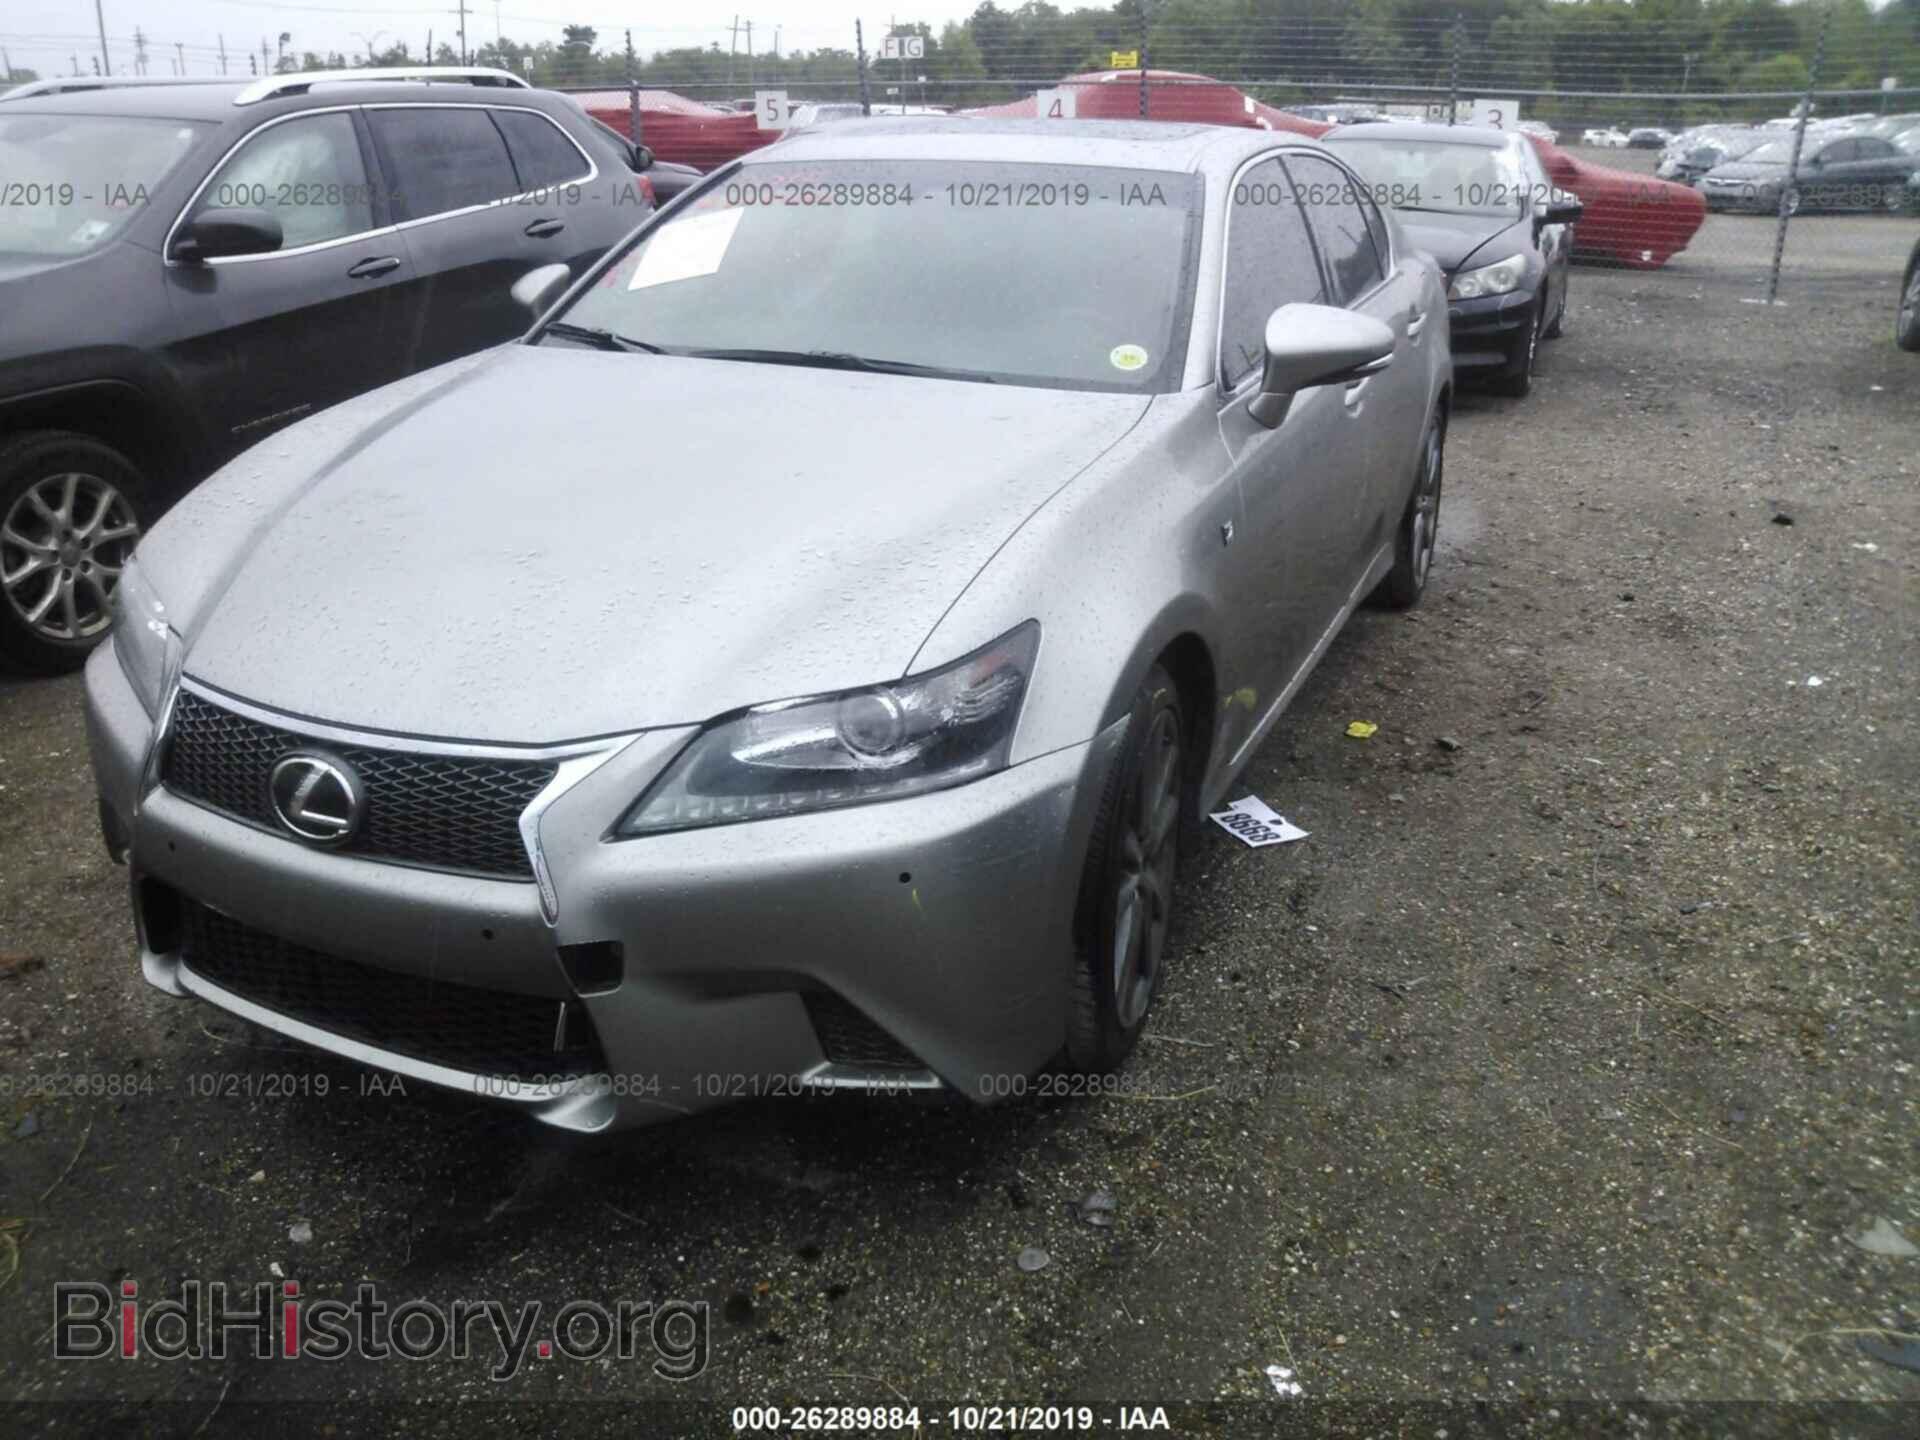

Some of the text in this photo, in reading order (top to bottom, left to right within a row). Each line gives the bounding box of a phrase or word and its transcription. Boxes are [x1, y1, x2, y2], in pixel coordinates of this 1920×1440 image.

[906, 37, 922, 57] G
[766, 98, 779, 122] 5
[1047, 98, 1064, 118] 4
